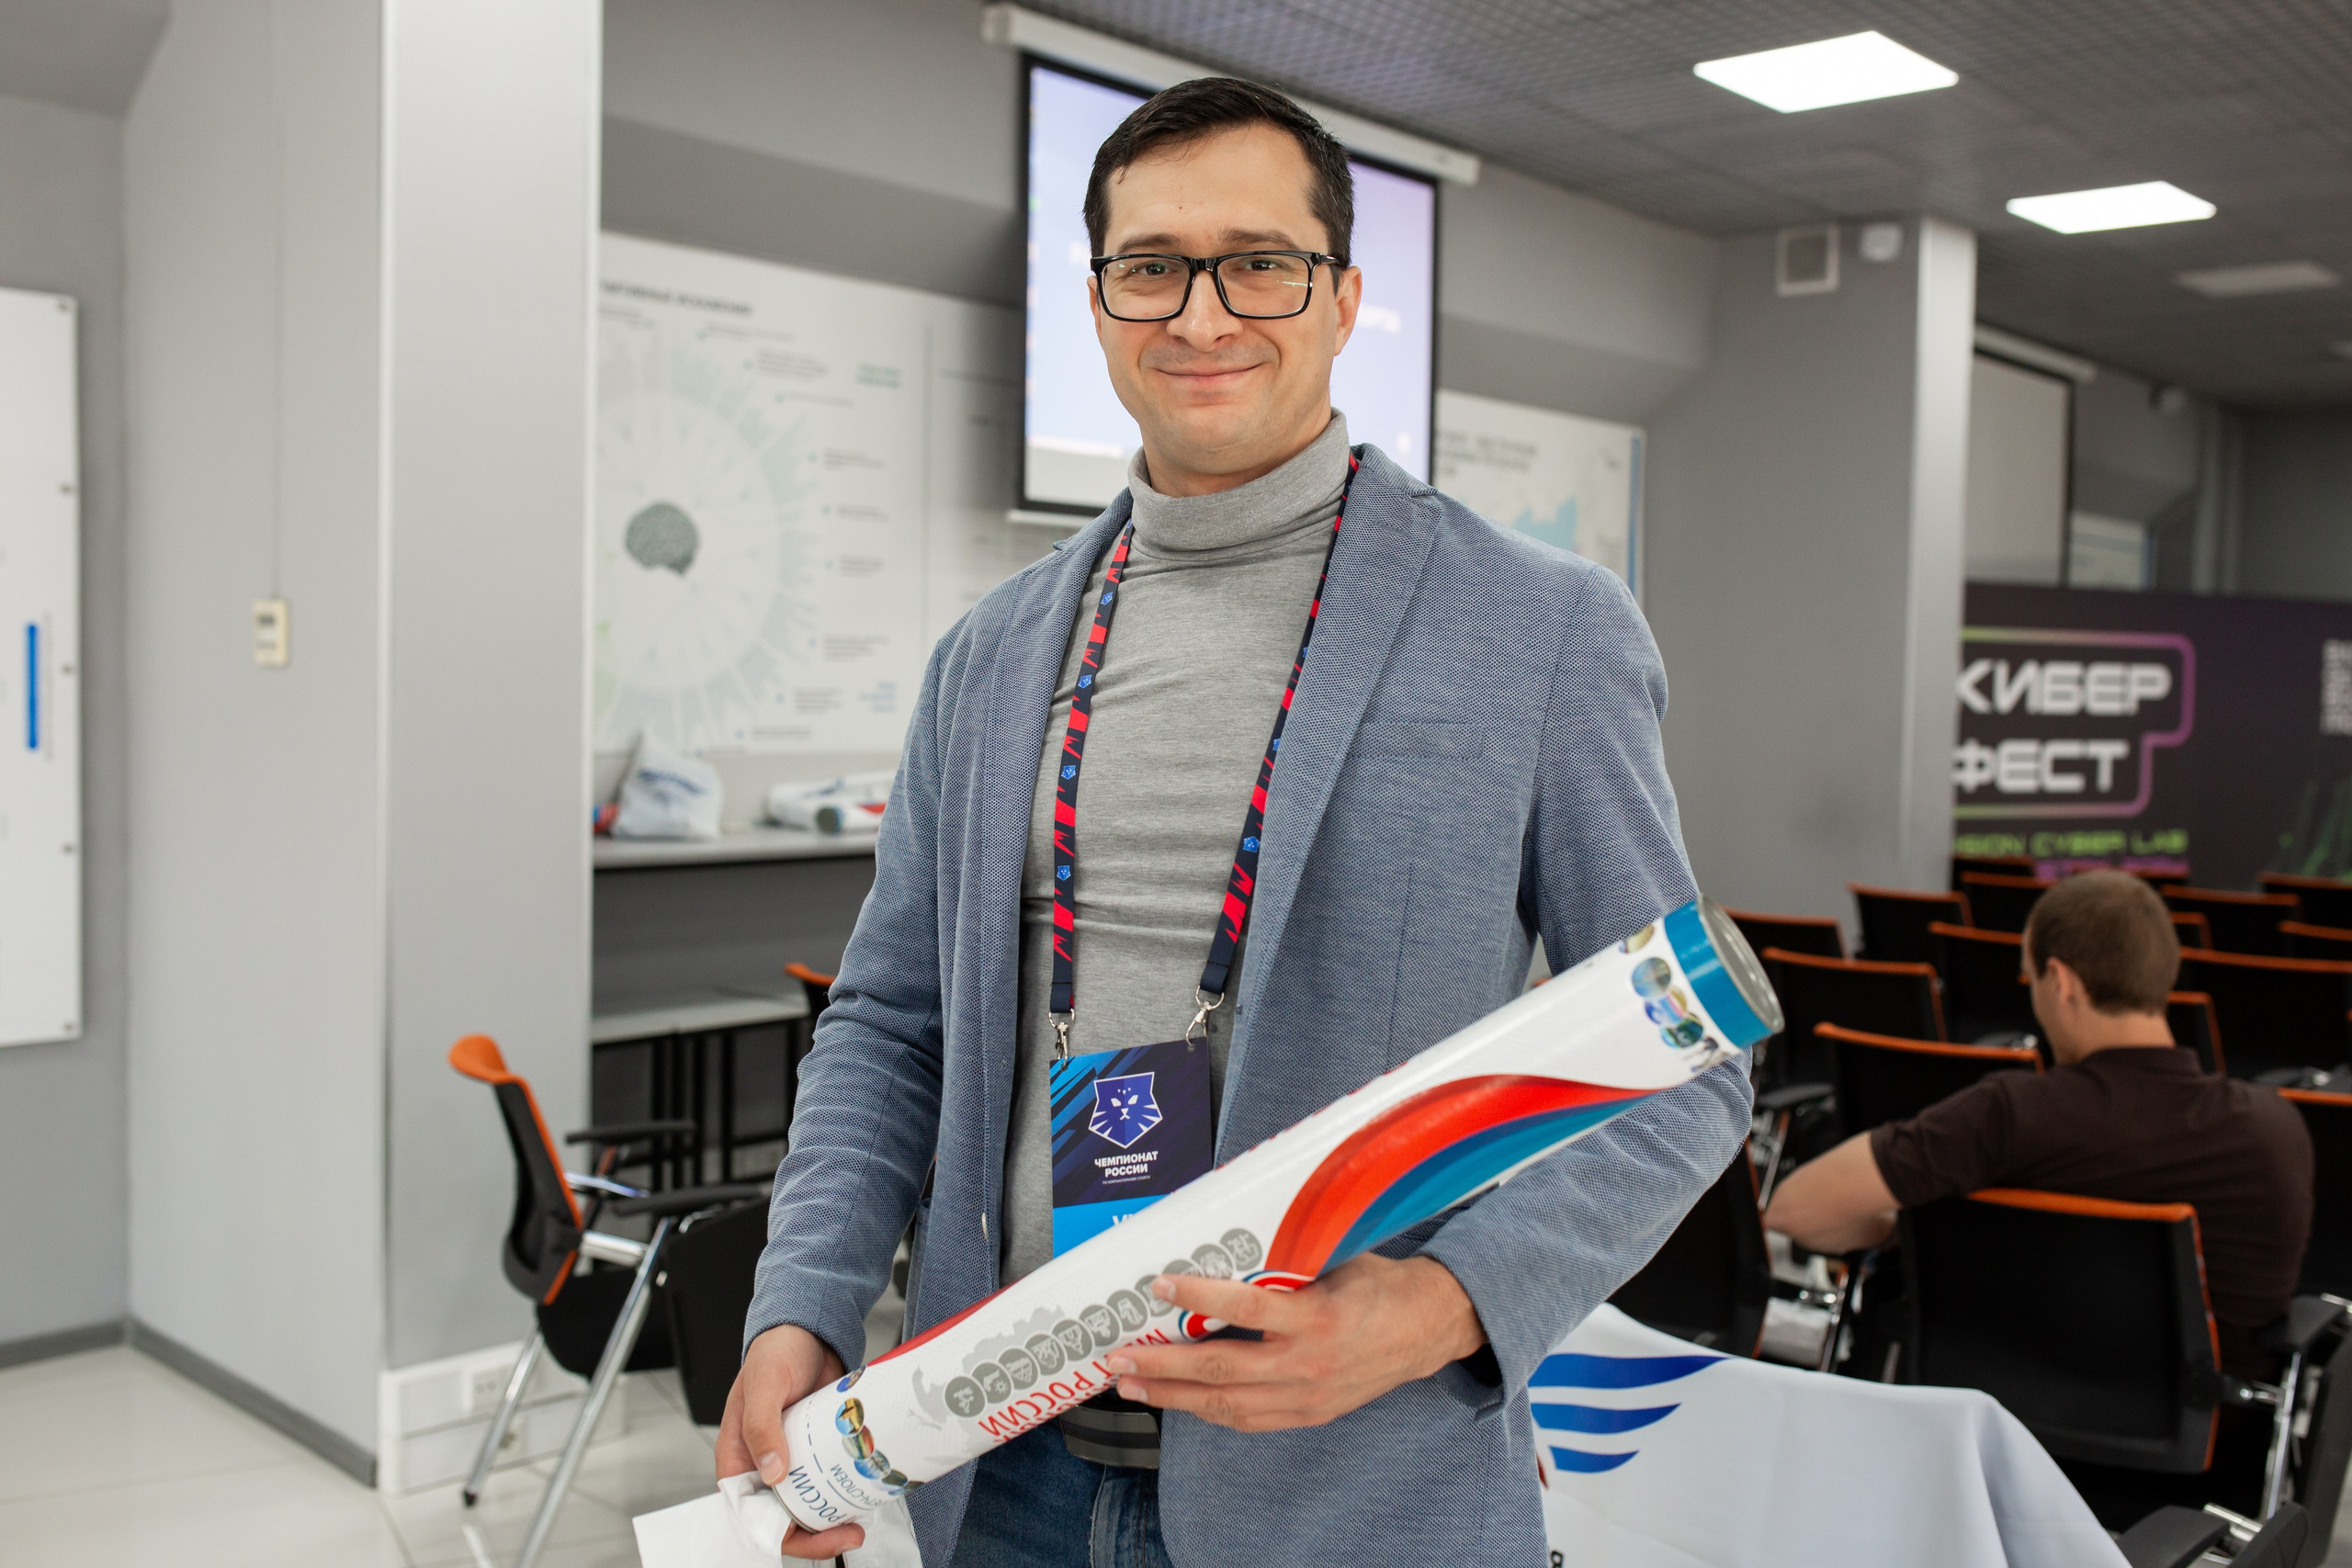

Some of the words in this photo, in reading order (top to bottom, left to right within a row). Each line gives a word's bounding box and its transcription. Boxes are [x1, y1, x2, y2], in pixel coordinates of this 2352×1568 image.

[1954, 659, 2172, 716] КИБЕР
[1951, 738, 2130, 793] ФЕСТ
[1094, 1151, 1158, 1168] ЧЕМПИОНАТ
[1105, 1164, 1148, 1177] РОССИИ
[978, 1371, 1095, 1438] РОССИИ
[788, 1465, 847, 1523] РОССИИ
